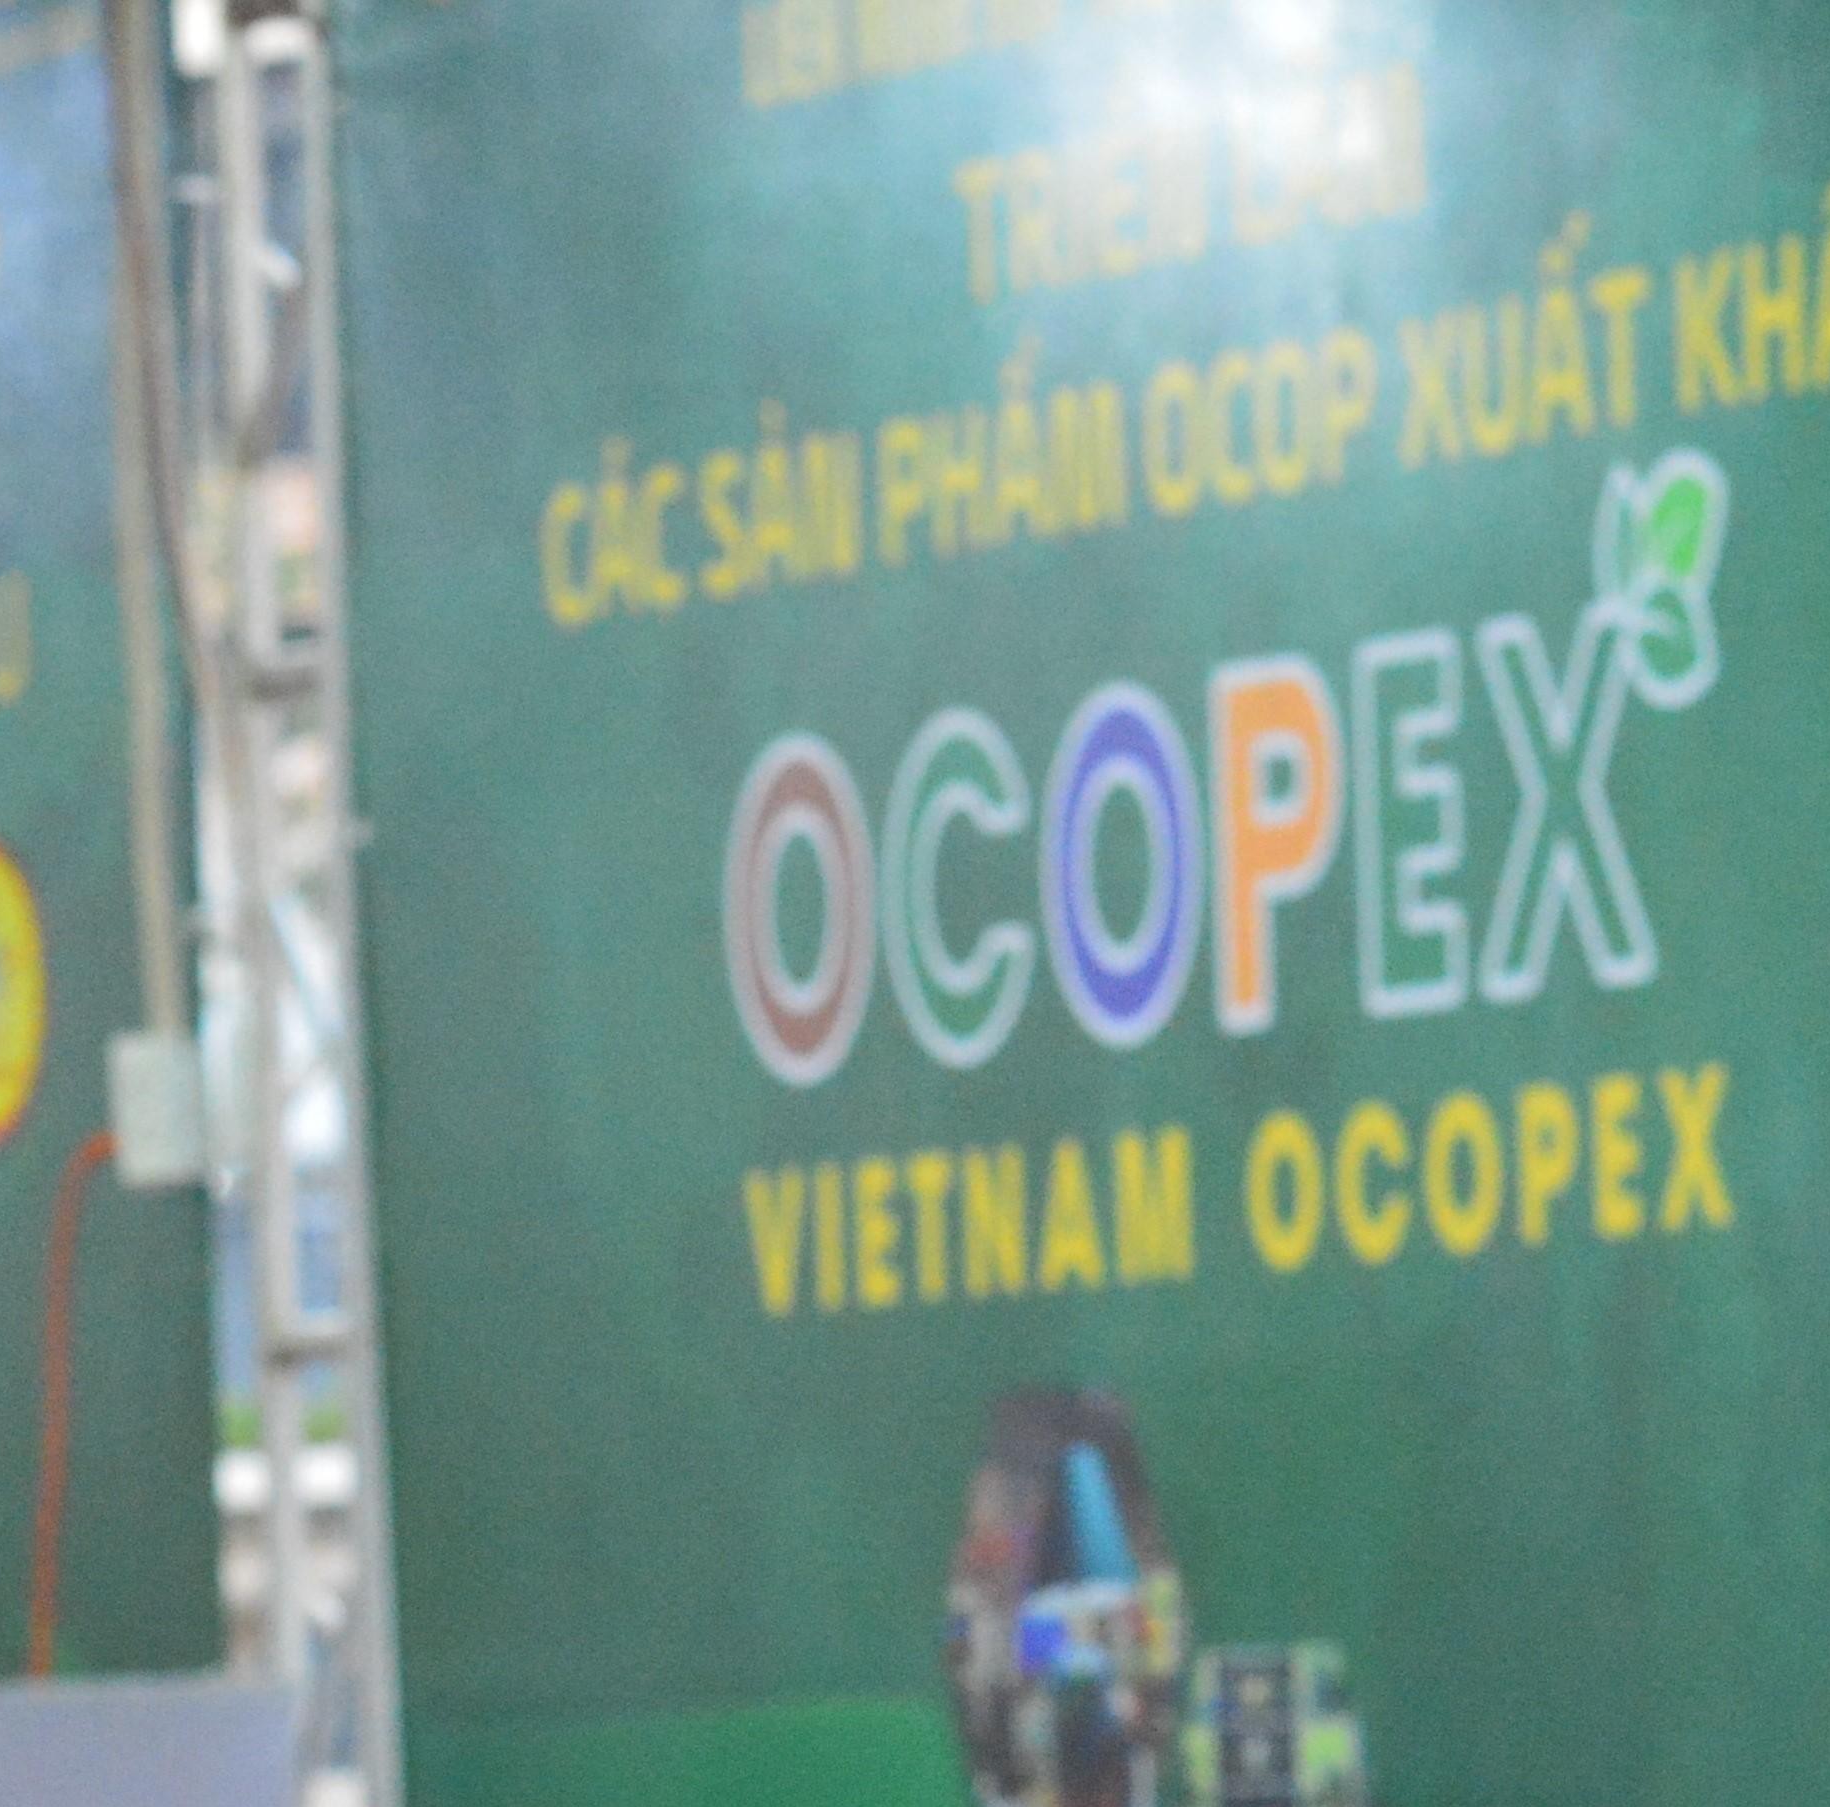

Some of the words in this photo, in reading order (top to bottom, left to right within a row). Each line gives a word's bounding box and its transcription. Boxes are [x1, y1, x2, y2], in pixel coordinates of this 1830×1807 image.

[540, 438, 686, 627] CÁC
[1143, 327, 1374, 518] OCOP
[1399, 215, 1649, 468] XUẤT
[721, 612, 1659, 1085] OCOPEX
[743, 1125, 1196, 1315] VIETNAM
[1243, 1065, 1734, 1273] OCOPEX
